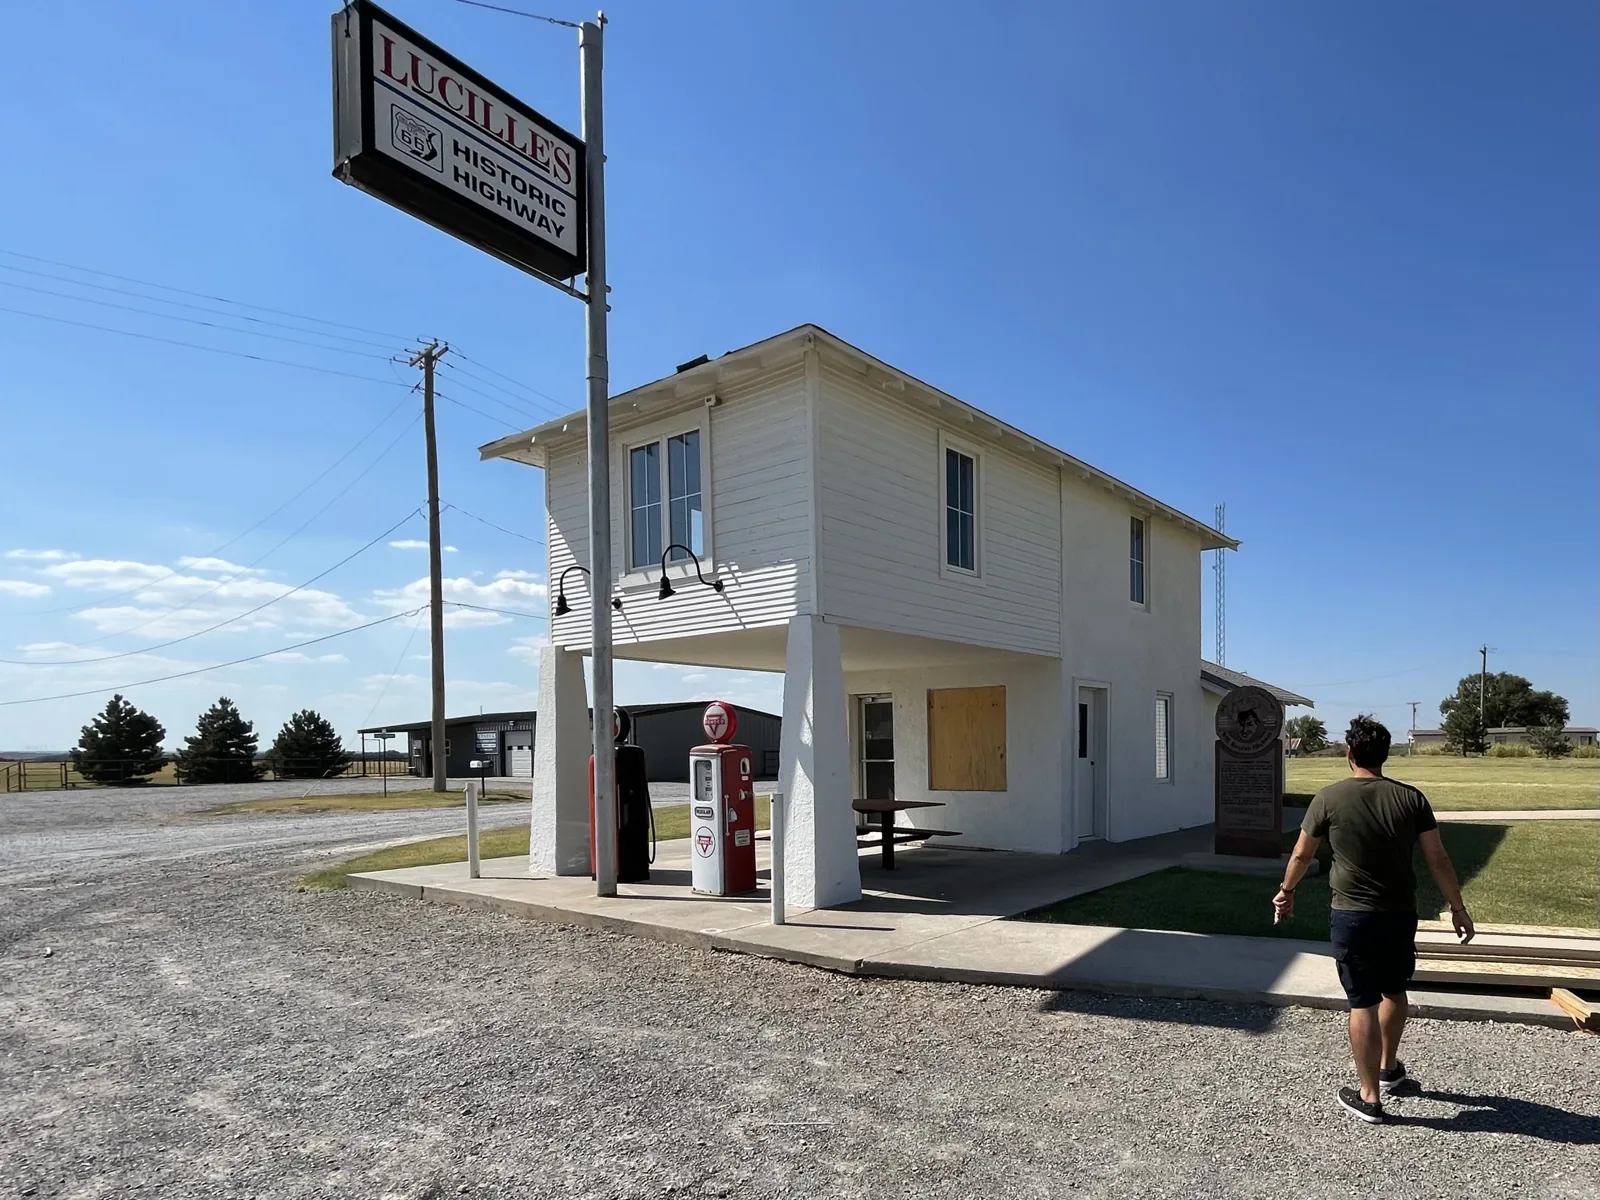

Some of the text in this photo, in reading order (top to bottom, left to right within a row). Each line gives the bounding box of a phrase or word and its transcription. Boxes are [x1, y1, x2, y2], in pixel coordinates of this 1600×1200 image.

[380, 33, 572, 185] LUCILLE'S
[401, 129, 425, 152] 66
[453, 139, 566, 217] HISTORIC
[453, 165, 565, 239] HIGHWAY
